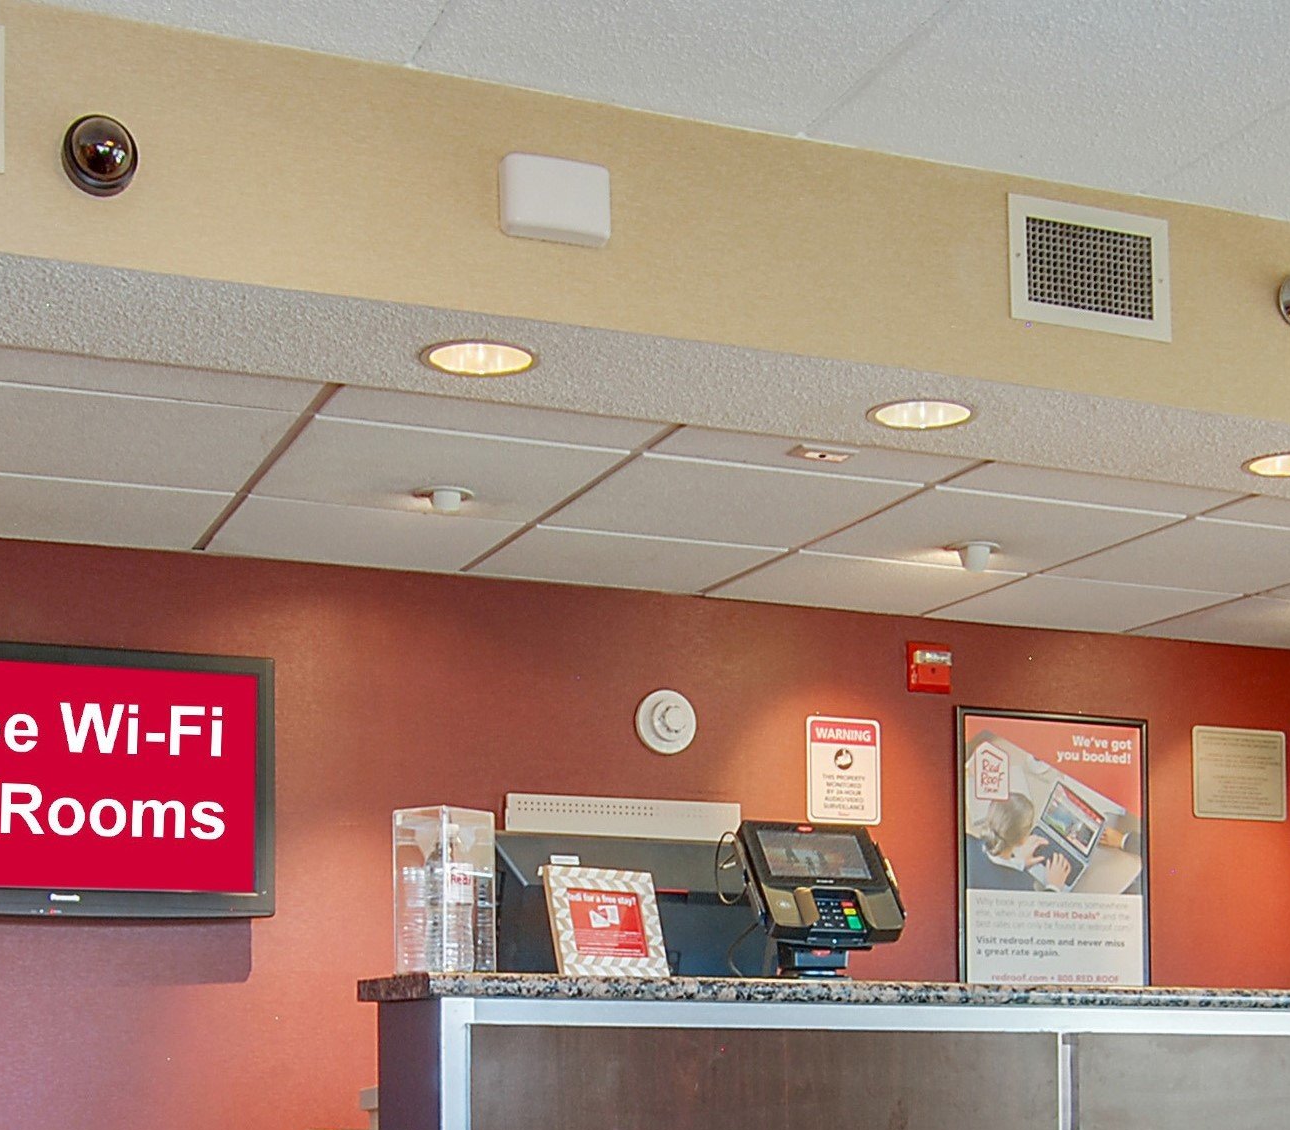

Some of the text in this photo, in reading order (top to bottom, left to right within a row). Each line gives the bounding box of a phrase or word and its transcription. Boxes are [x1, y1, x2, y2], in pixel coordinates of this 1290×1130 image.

[60, 702, 223, 757] Wi-Fi
[815, 727, 871, 742] WARNING
[1072, 735, 1132, 752] We've got
[1057, 751, 1131, 764] you booked!
[982, 758, 1001, 772] Red
[980, 772, 1005, 787] Roof
[0, 782, 225, 840] Rooms
[1034, 909, 1050, 919] Red
[1053, 910, 1069, 919] Hot
[976, 936, 997, 945] Visit
[1057, 938, 1075, 947] and
[1077, 940, 1103, 948] never
[1105, 940, 1126, 948] miss
[984, 948, 1009, 958] great
